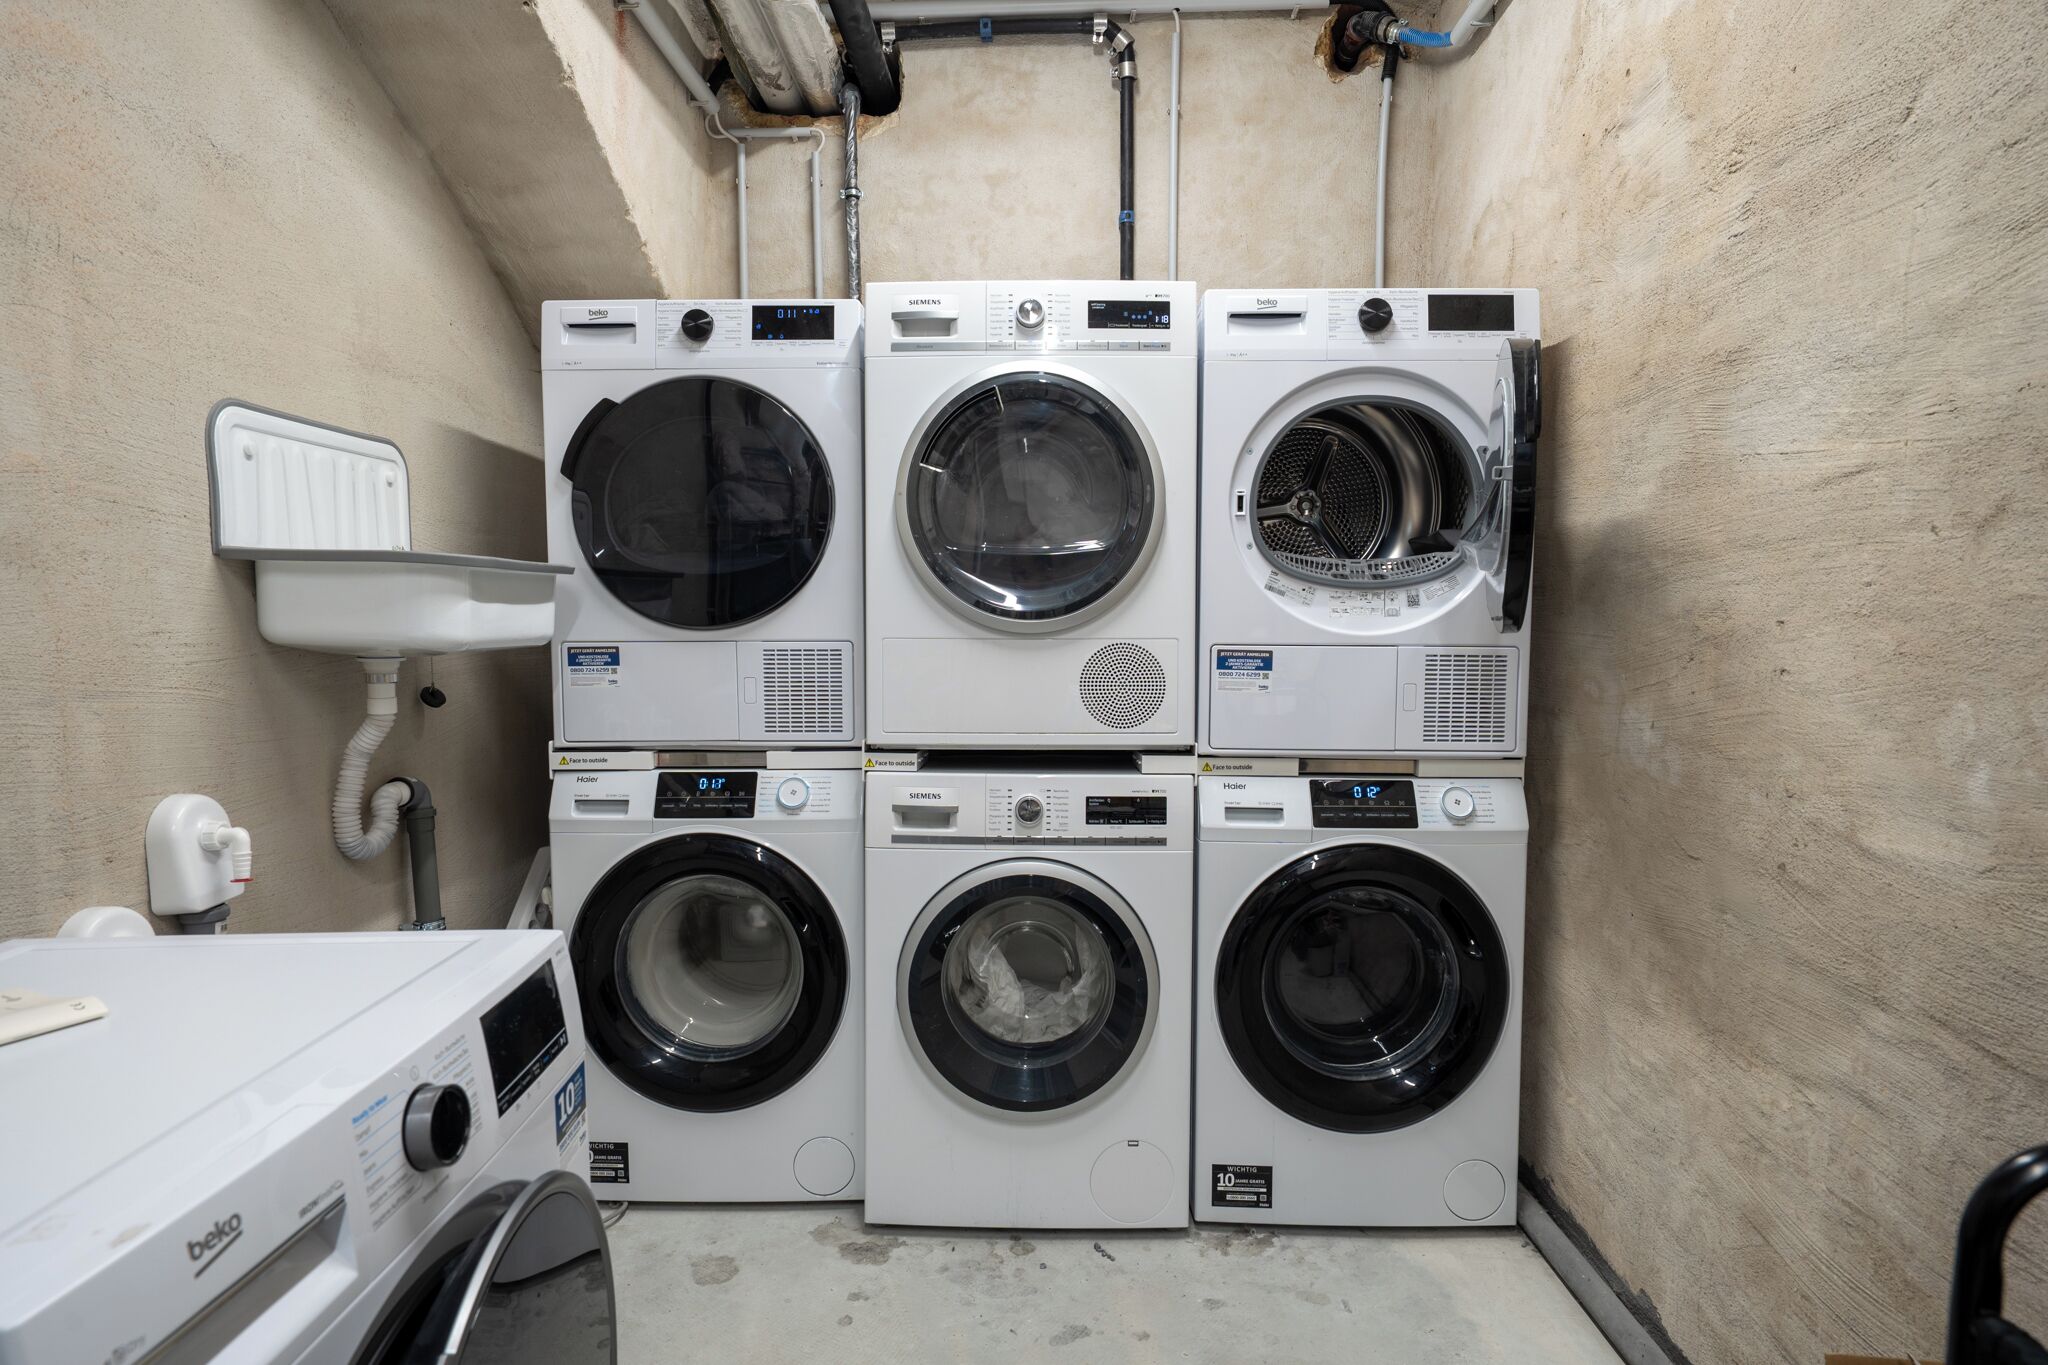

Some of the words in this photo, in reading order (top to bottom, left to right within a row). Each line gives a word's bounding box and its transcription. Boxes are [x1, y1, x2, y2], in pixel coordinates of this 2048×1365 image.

[1256, 298, 1278, 307] beko
[588, 309, 609, 317] beko
[1223, 782, 1247, 790] Haier
[909, 792, 942, 800] SIEMENS
[558, 1081, 575, 1127] 10
[1217, 1172, 1235, 1187] 10
[186, 1212, 243, 1262] beko
